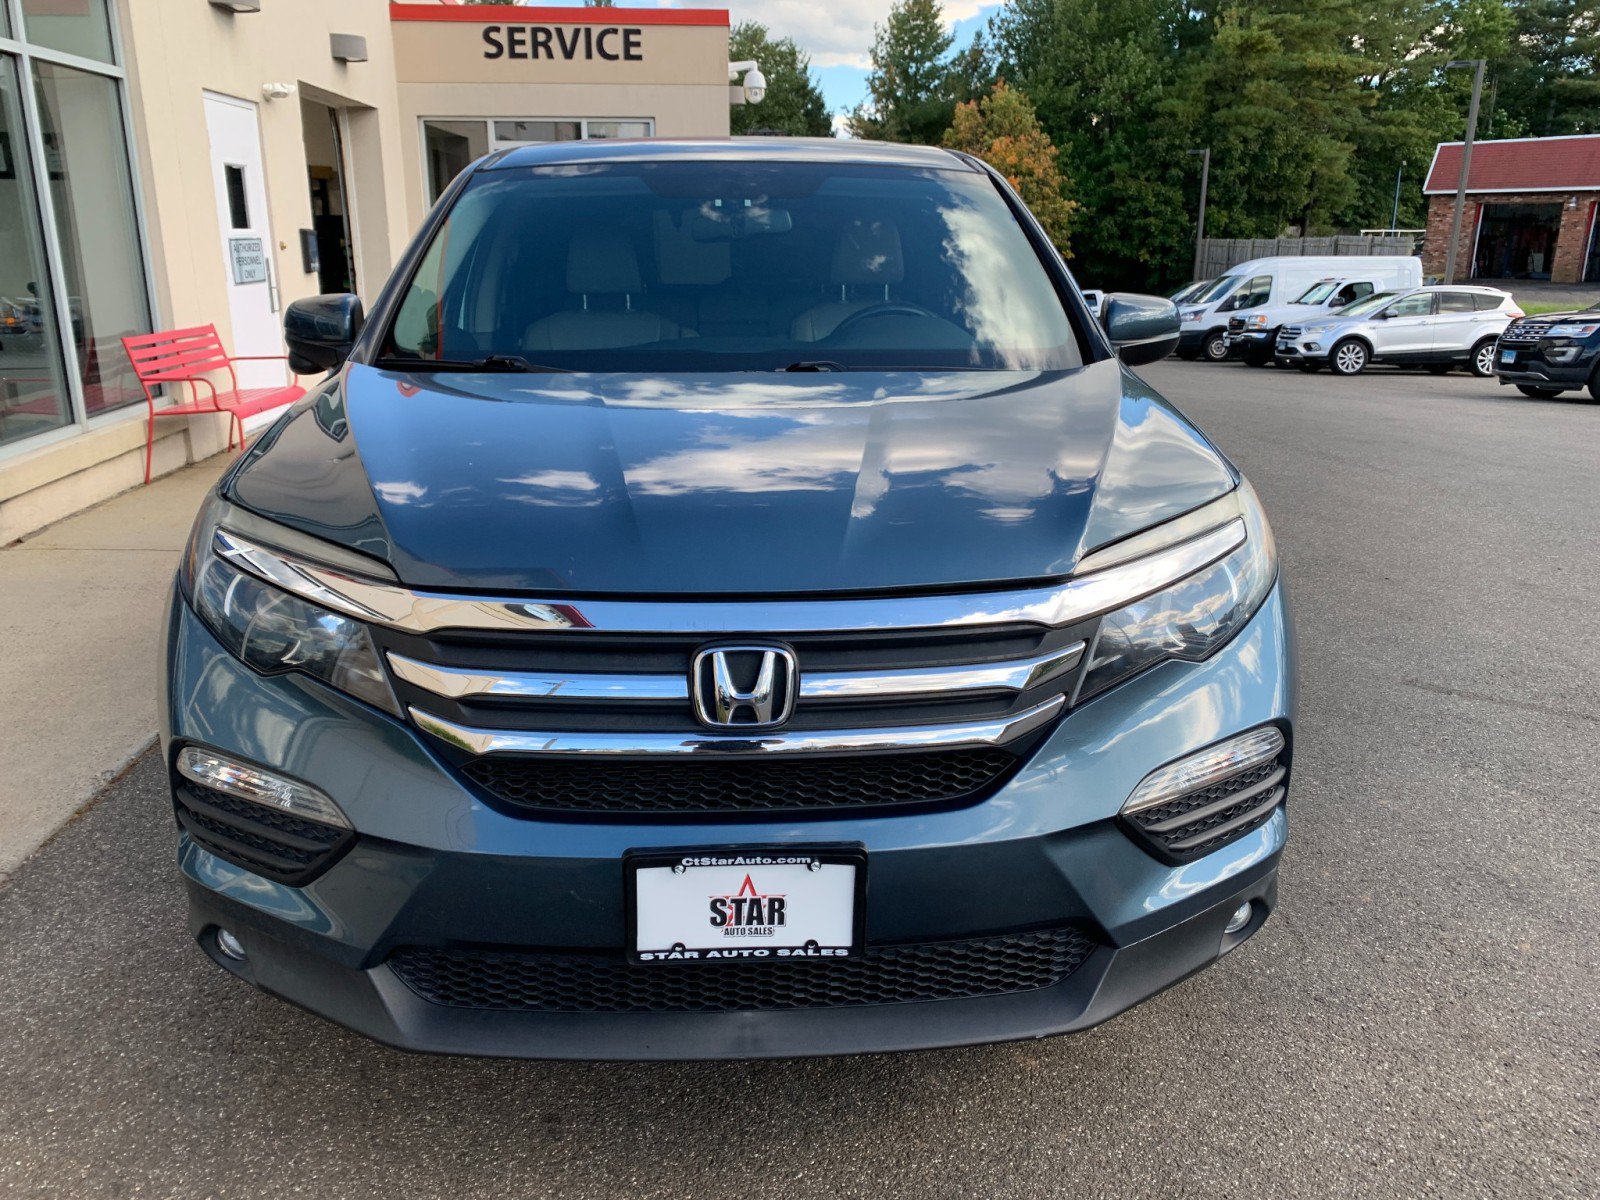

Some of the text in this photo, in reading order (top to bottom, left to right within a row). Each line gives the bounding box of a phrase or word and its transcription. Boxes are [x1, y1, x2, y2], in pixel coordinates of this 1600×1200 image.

[482, 26, 643, 61] SERVICE
[233, 243, 261, 252] AUTHORIZED
[235, 256, 262, 266] PERSONNEL
[244, 269, 256, 278] ONLY
[681, 856, 811, 866] CtStarAuto.com
[709, 897, 786, 927] STAR
[724, 926, 773, 936] AUTO SALES
[640, 948, 849, 961] STAR AUTO SALES
